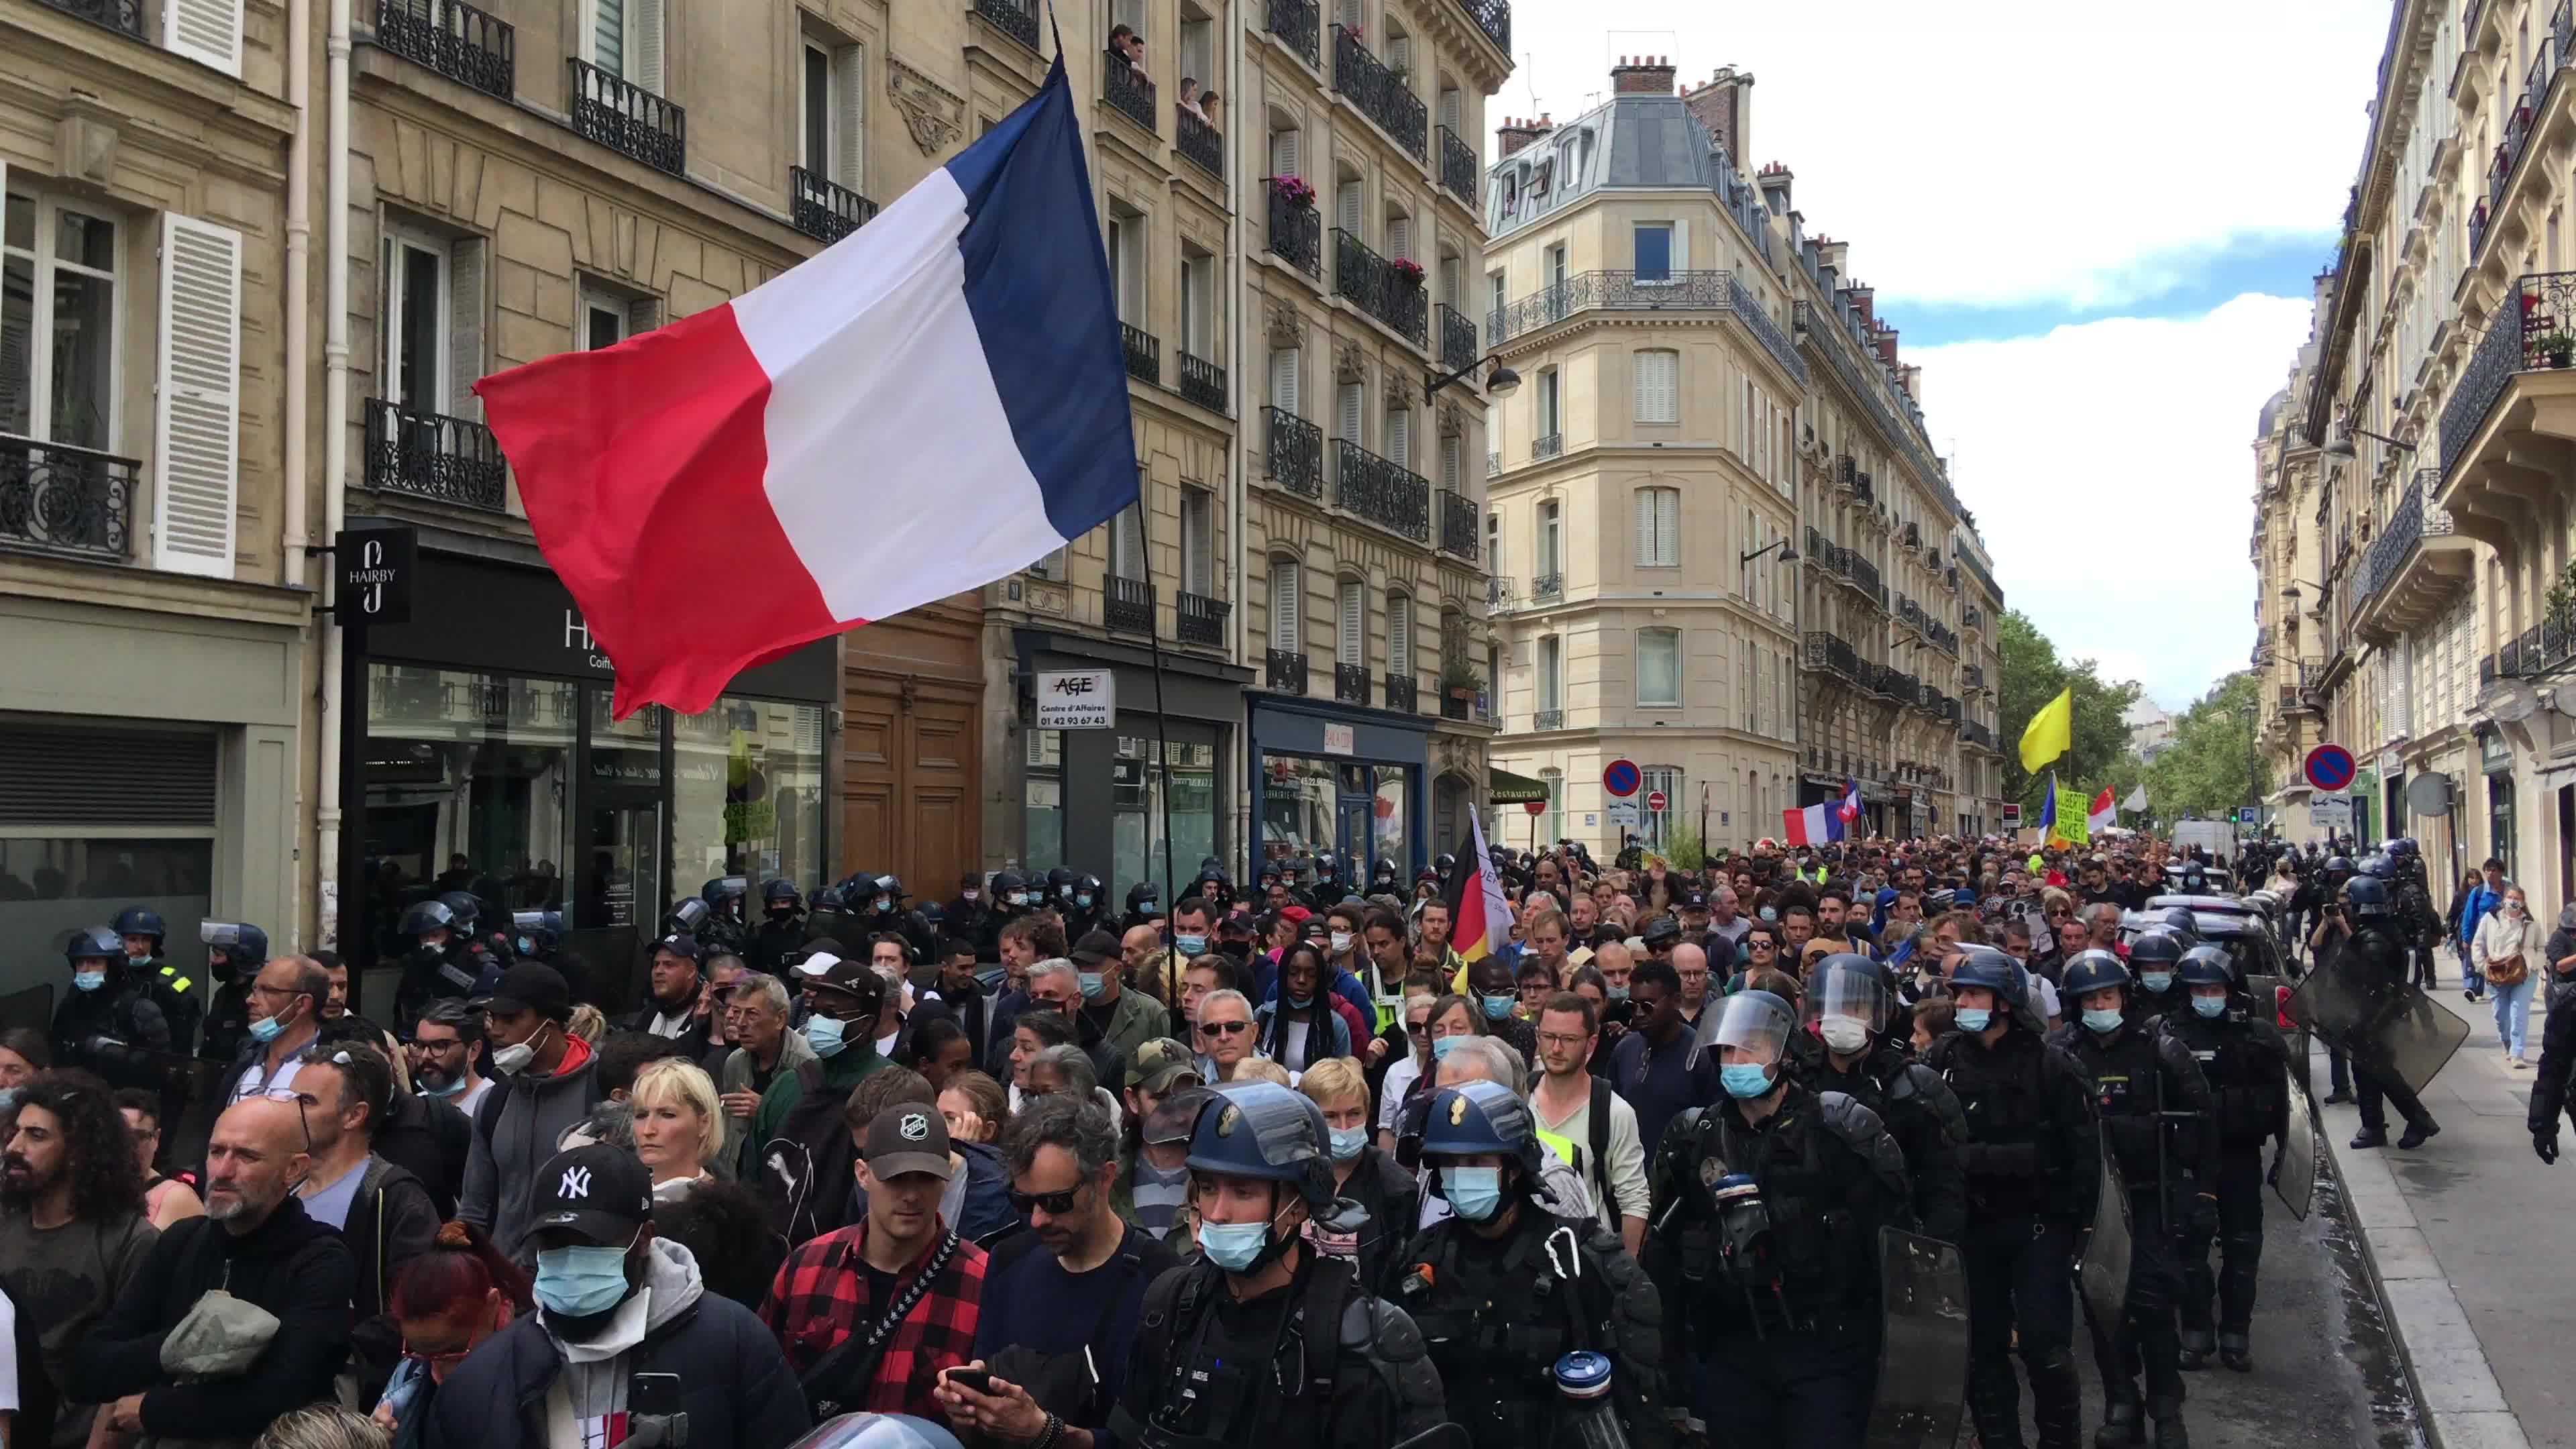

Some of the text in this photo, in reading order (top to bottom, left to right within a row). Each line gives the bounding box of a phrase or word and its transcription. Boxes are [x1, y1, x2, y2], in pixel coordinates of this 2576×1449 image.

[350, 569, 396, 584] HAIRBY
[565, 608, 595, 650] H
[1053, 676, 1093, 697] AGE
[1067, 704, 1106, 712] d'Affaires
[1053, 717, 1065, 725] 42
[1081, 716, 1092, 724] 67
[1489, 788, 1542, 798] Restaurant
[2244, 810, 2252, 820] P
[907, 1119, 925, 1134] NHL
[557, 1166, 592, 1199] NY
